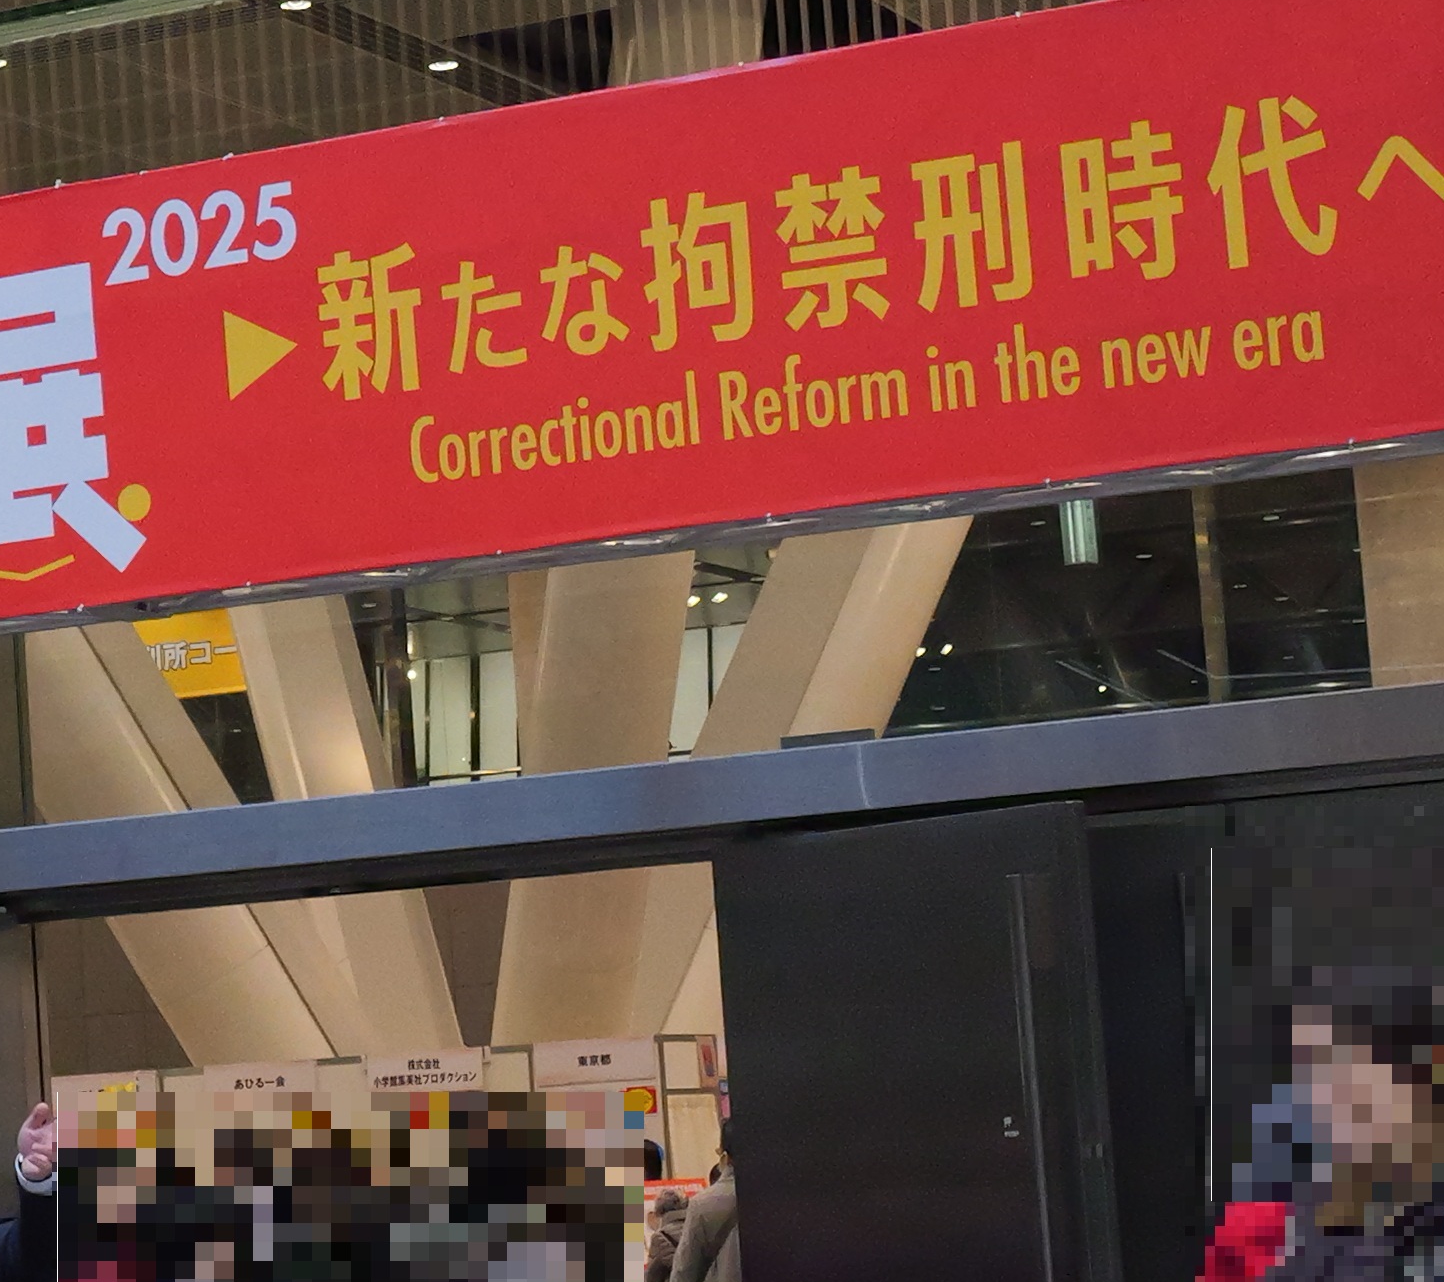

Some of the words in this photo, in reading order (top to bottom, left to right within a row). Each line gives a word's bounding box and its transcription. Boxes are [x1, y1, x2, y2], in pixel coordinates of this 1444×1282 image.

[102, 181, 297, 286] 2025
[411, 369, 700, 484] Correctional
[722, 355, 909, 442] Reform
[926, 345, 976, 412] in
[995, 323, 1081, 403] the
[1102, 327, 1211, 391] new
[1233, 311, 1324, 370] era
[407, 1058, 441, 1071] 株式会社
[577, 1053, 612, 1067] 東京都
